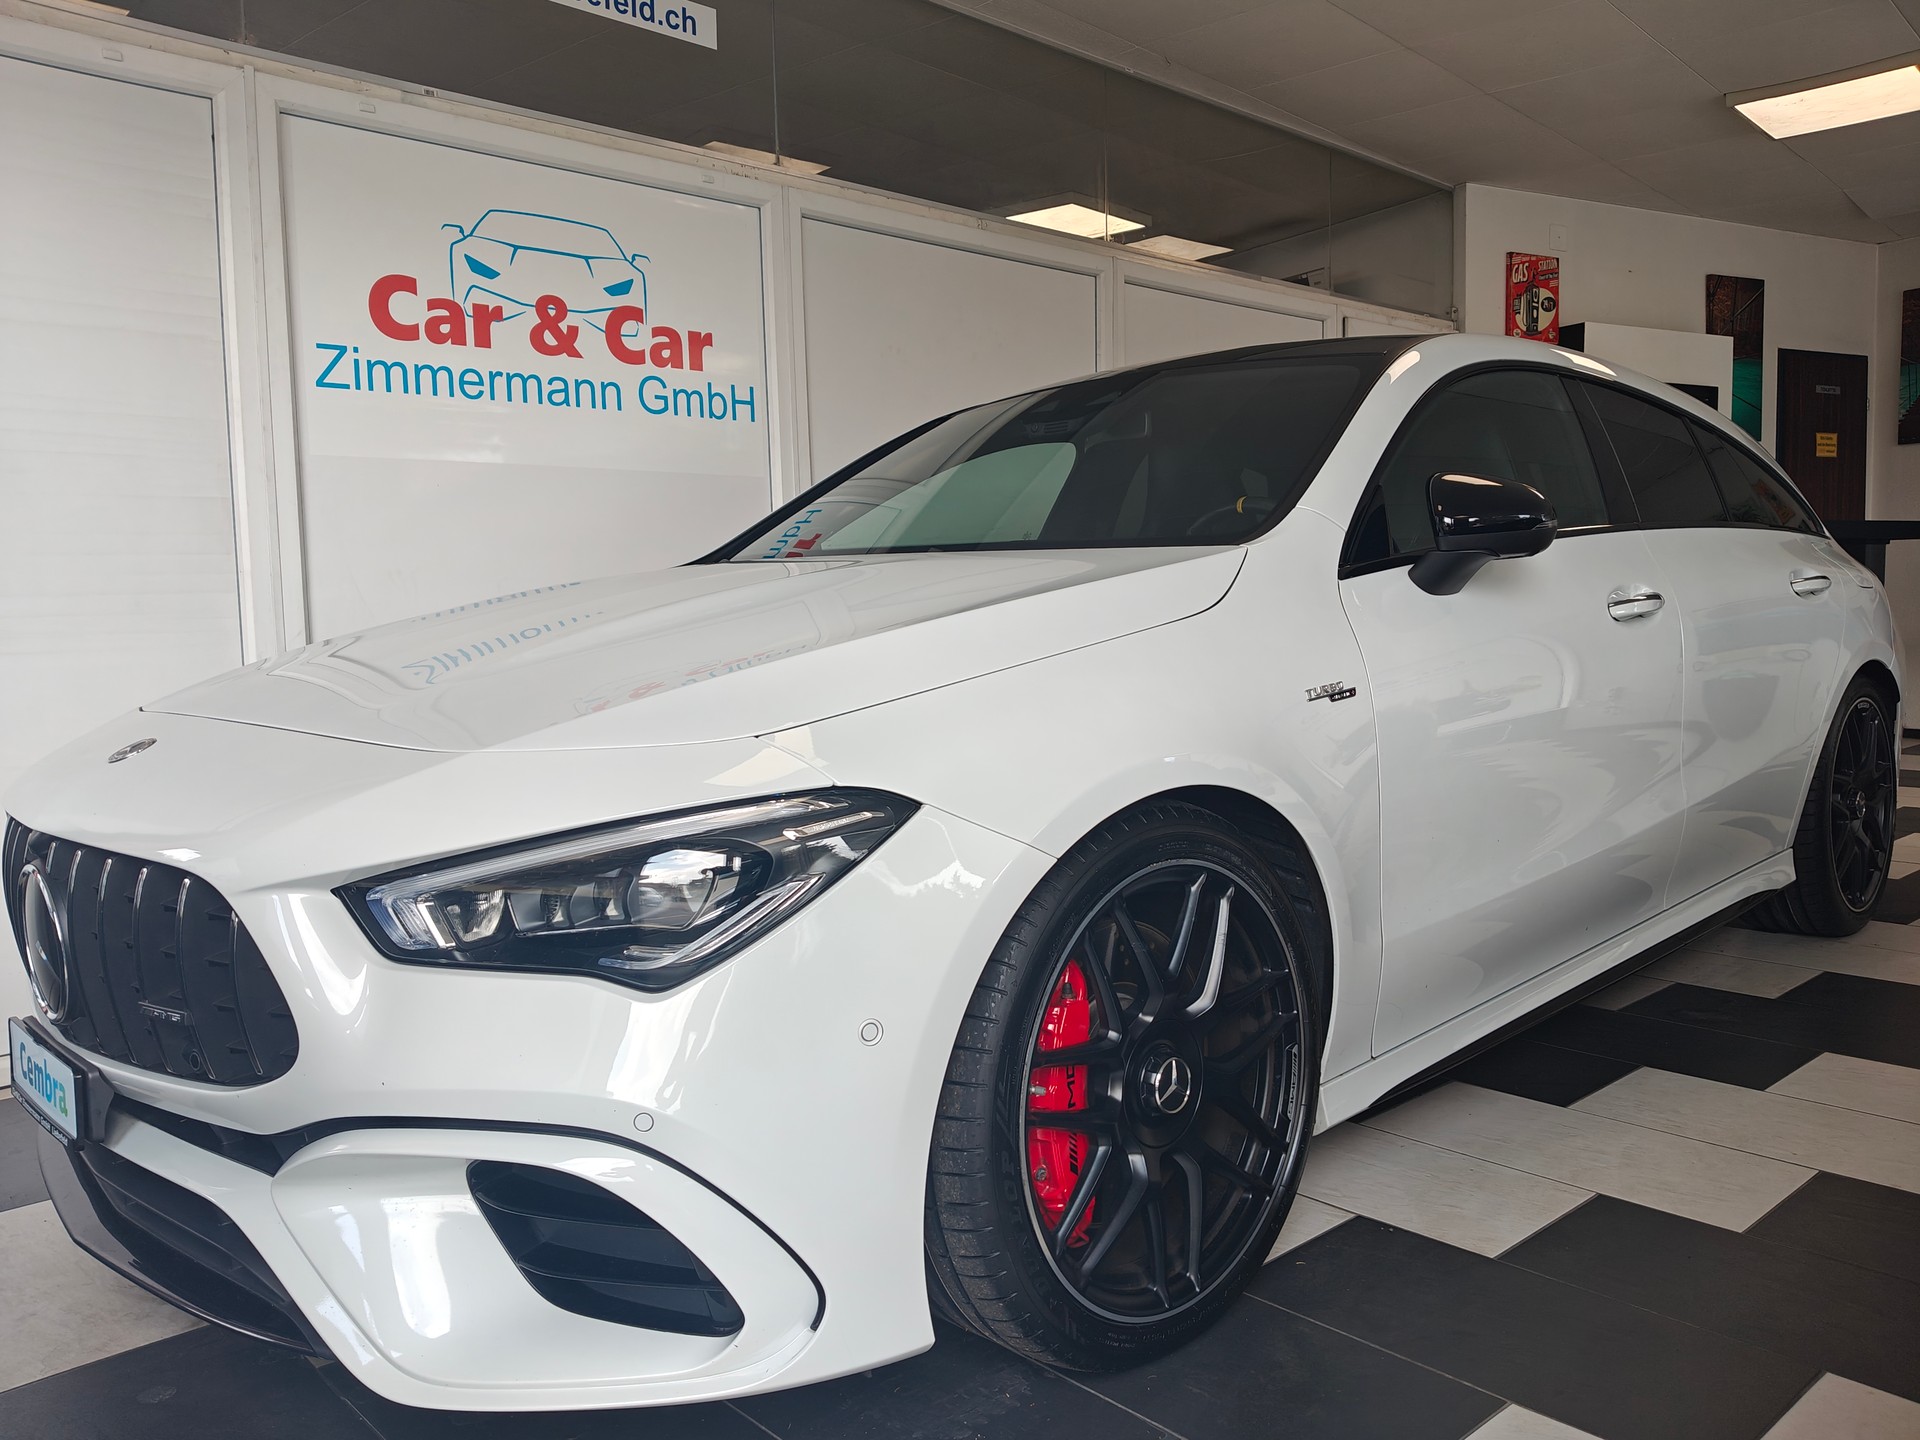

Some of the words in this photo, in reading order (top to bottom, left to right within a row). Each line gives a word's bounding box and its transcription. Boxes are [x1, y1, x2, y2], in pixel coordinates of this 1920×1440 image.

[577, 0, 697, 36] eld.ch
[1512, 263, 1529, 283] GAS
[368, 274, 504, 350] Car
[529, 294, 584, 359] &
[604, 305, 713, 372] Car
[315, 343, 622, 412] Zimmermann
[638, 376, 755, 423] GmbH
[1305, 681, 1344, 698] TURBO
[19, 1042, 68, 1117] Cembra
